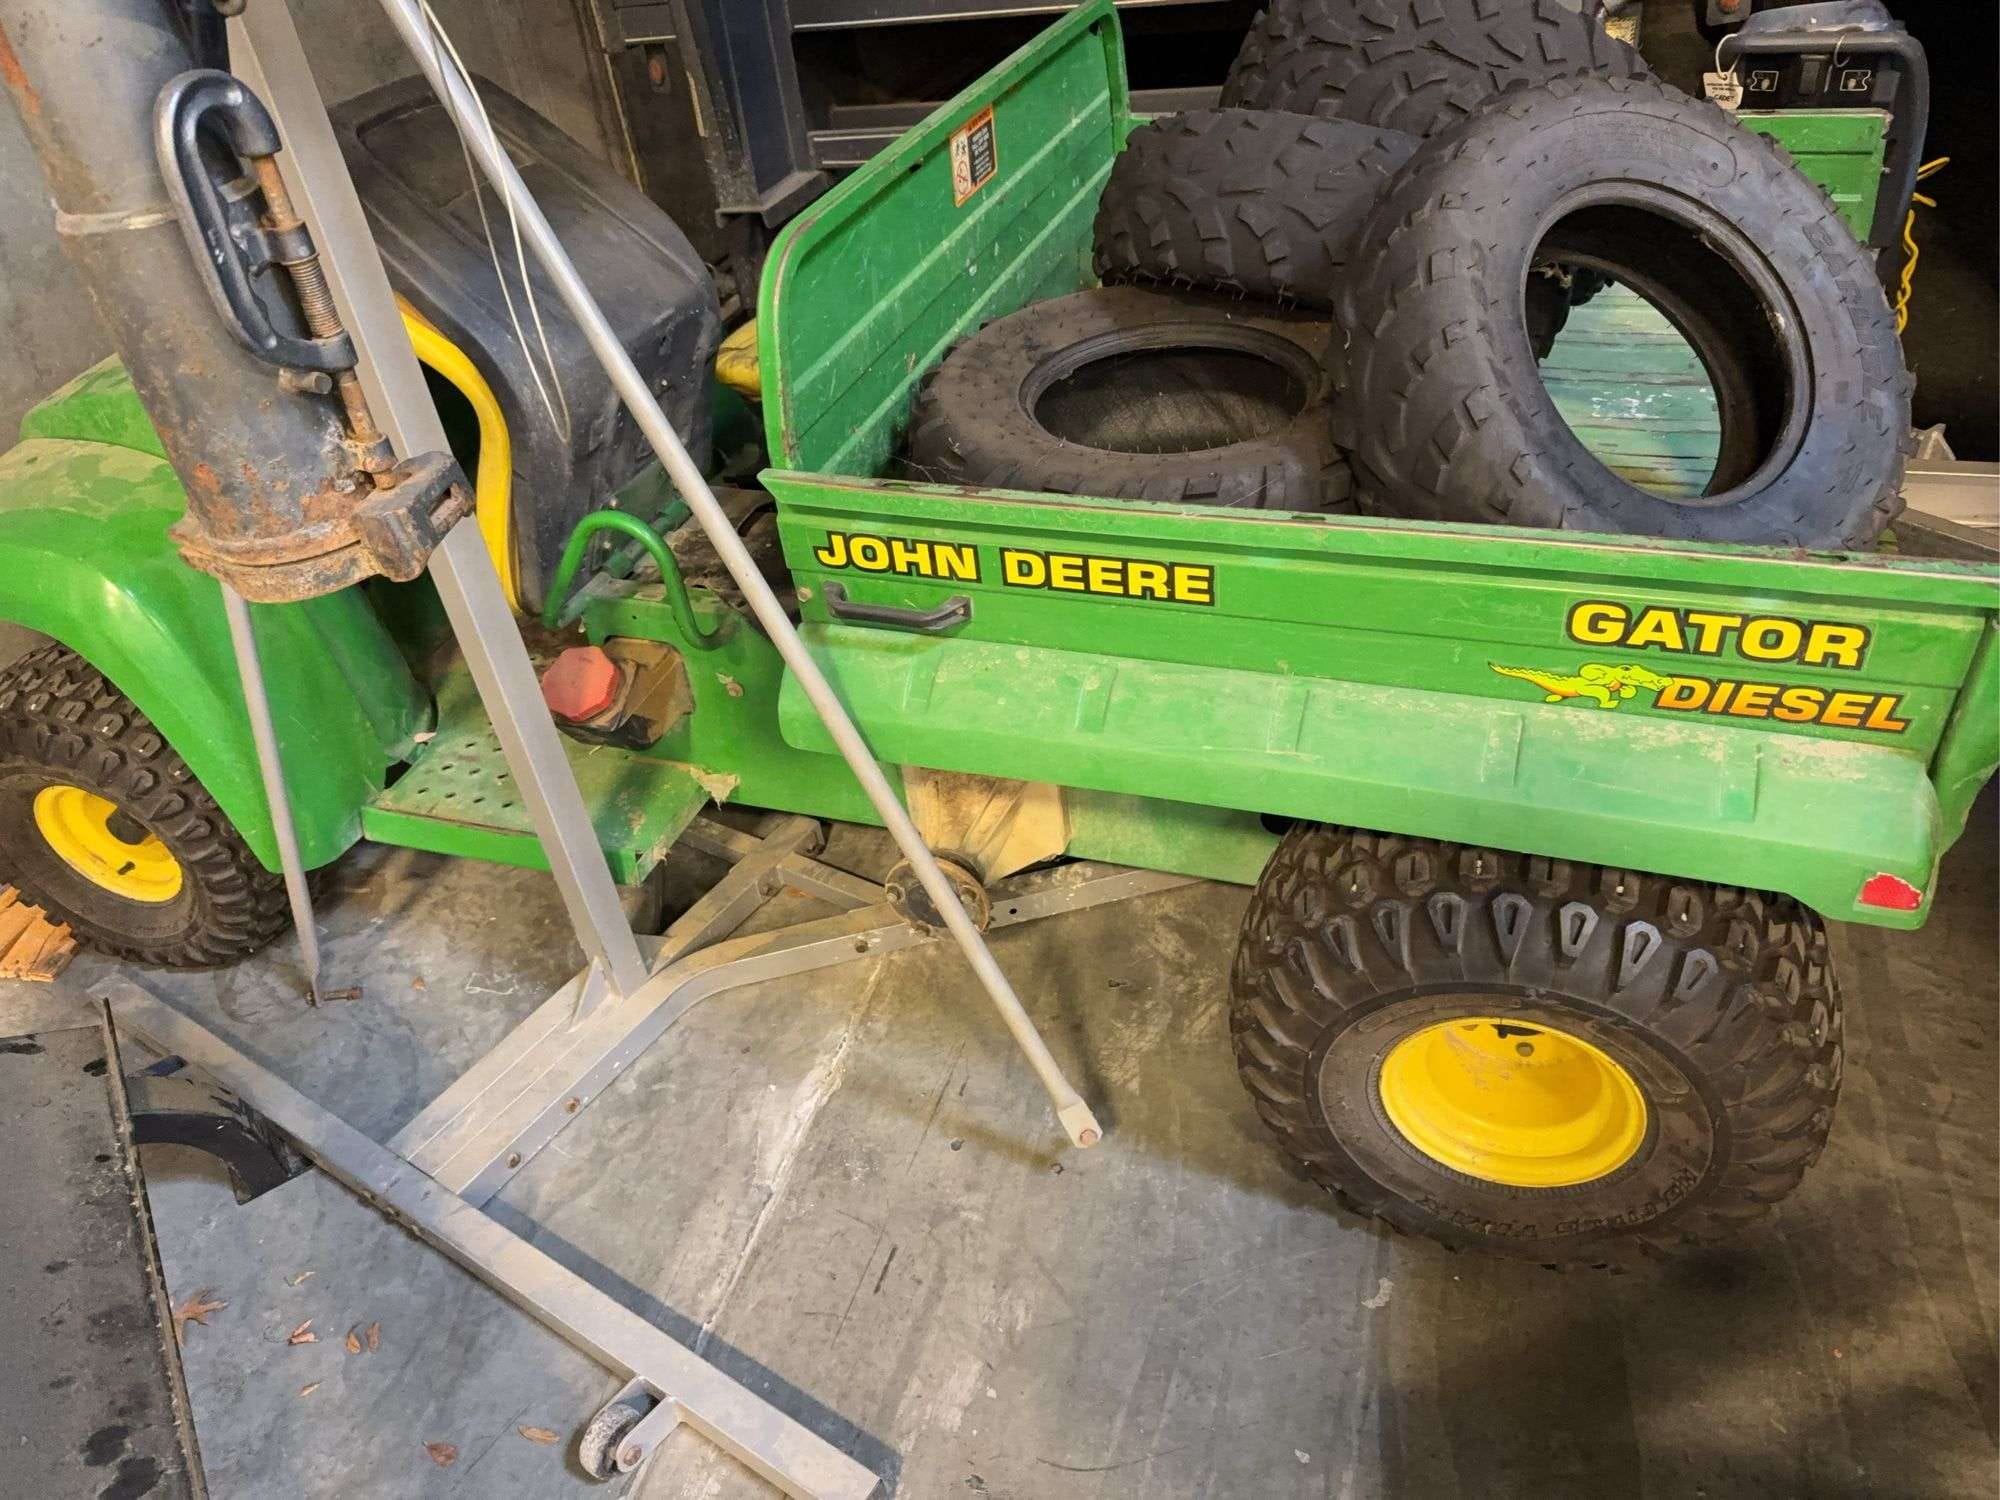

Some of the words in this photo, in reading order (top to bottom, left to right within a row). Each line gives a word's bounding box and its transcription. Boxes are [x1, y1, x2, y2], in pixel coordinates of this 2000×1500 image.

[815, 532, 980, 582] JOHN
[1001, 548, 1213, 604] DEERE
[1568, 601, 1869, 669] GATOR
[1655, 675, 1908, 733] DIESEL
